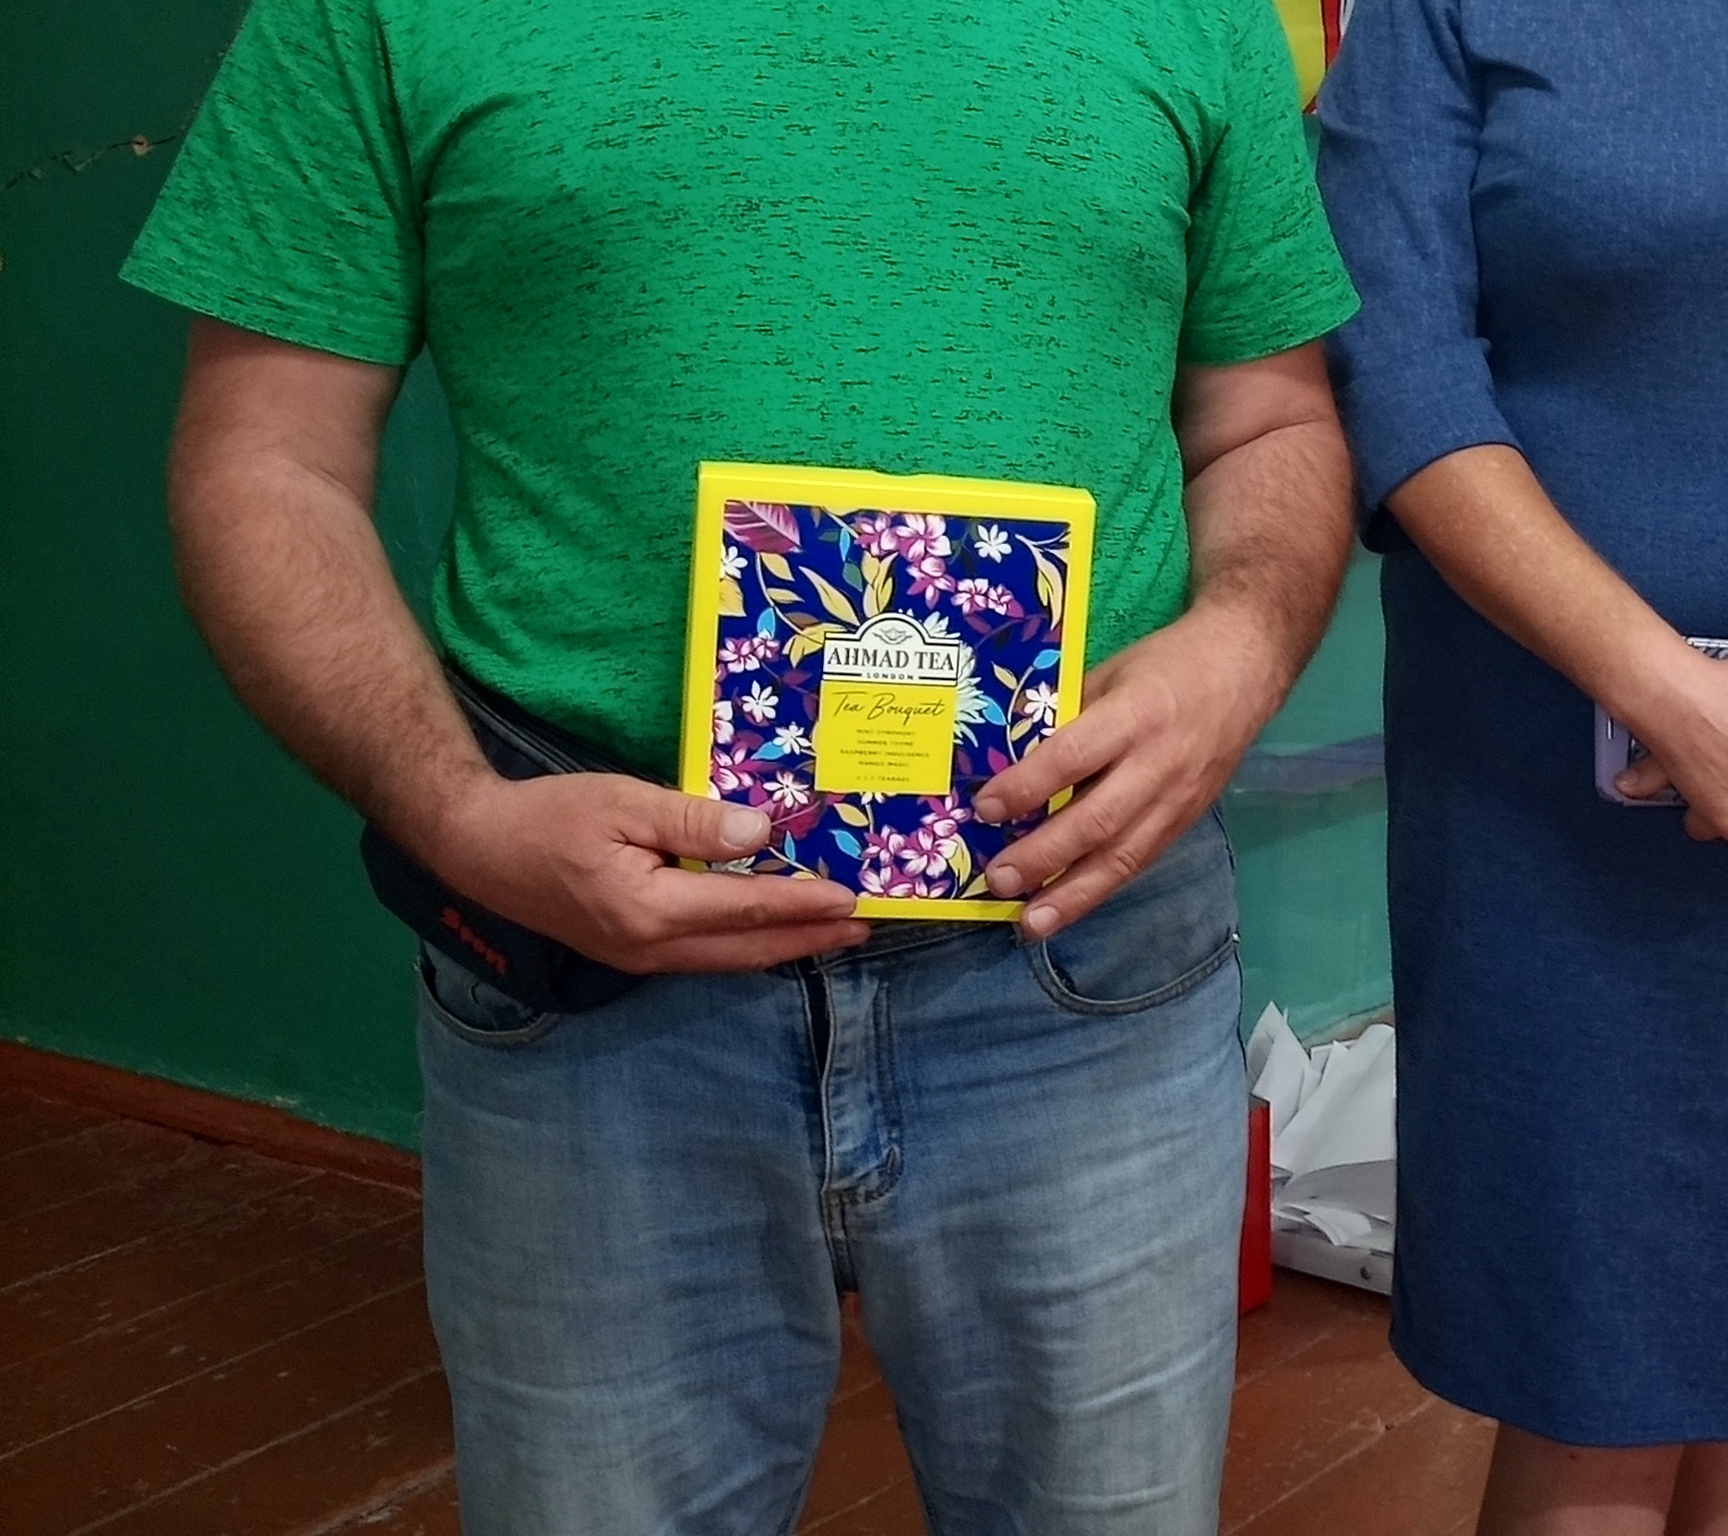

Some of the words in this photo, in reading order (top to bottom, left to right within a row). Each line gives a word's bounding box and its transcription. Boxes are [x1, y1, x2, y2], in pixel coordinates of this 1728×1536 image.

[827, 647, 909, 668] AHMAD
[914, 651, 954, 671] TEA
[866, 672, 914, 680] LONDON
[832, 691, 868, 716] Tea
[866, 693, 945, 726] Bouquet
